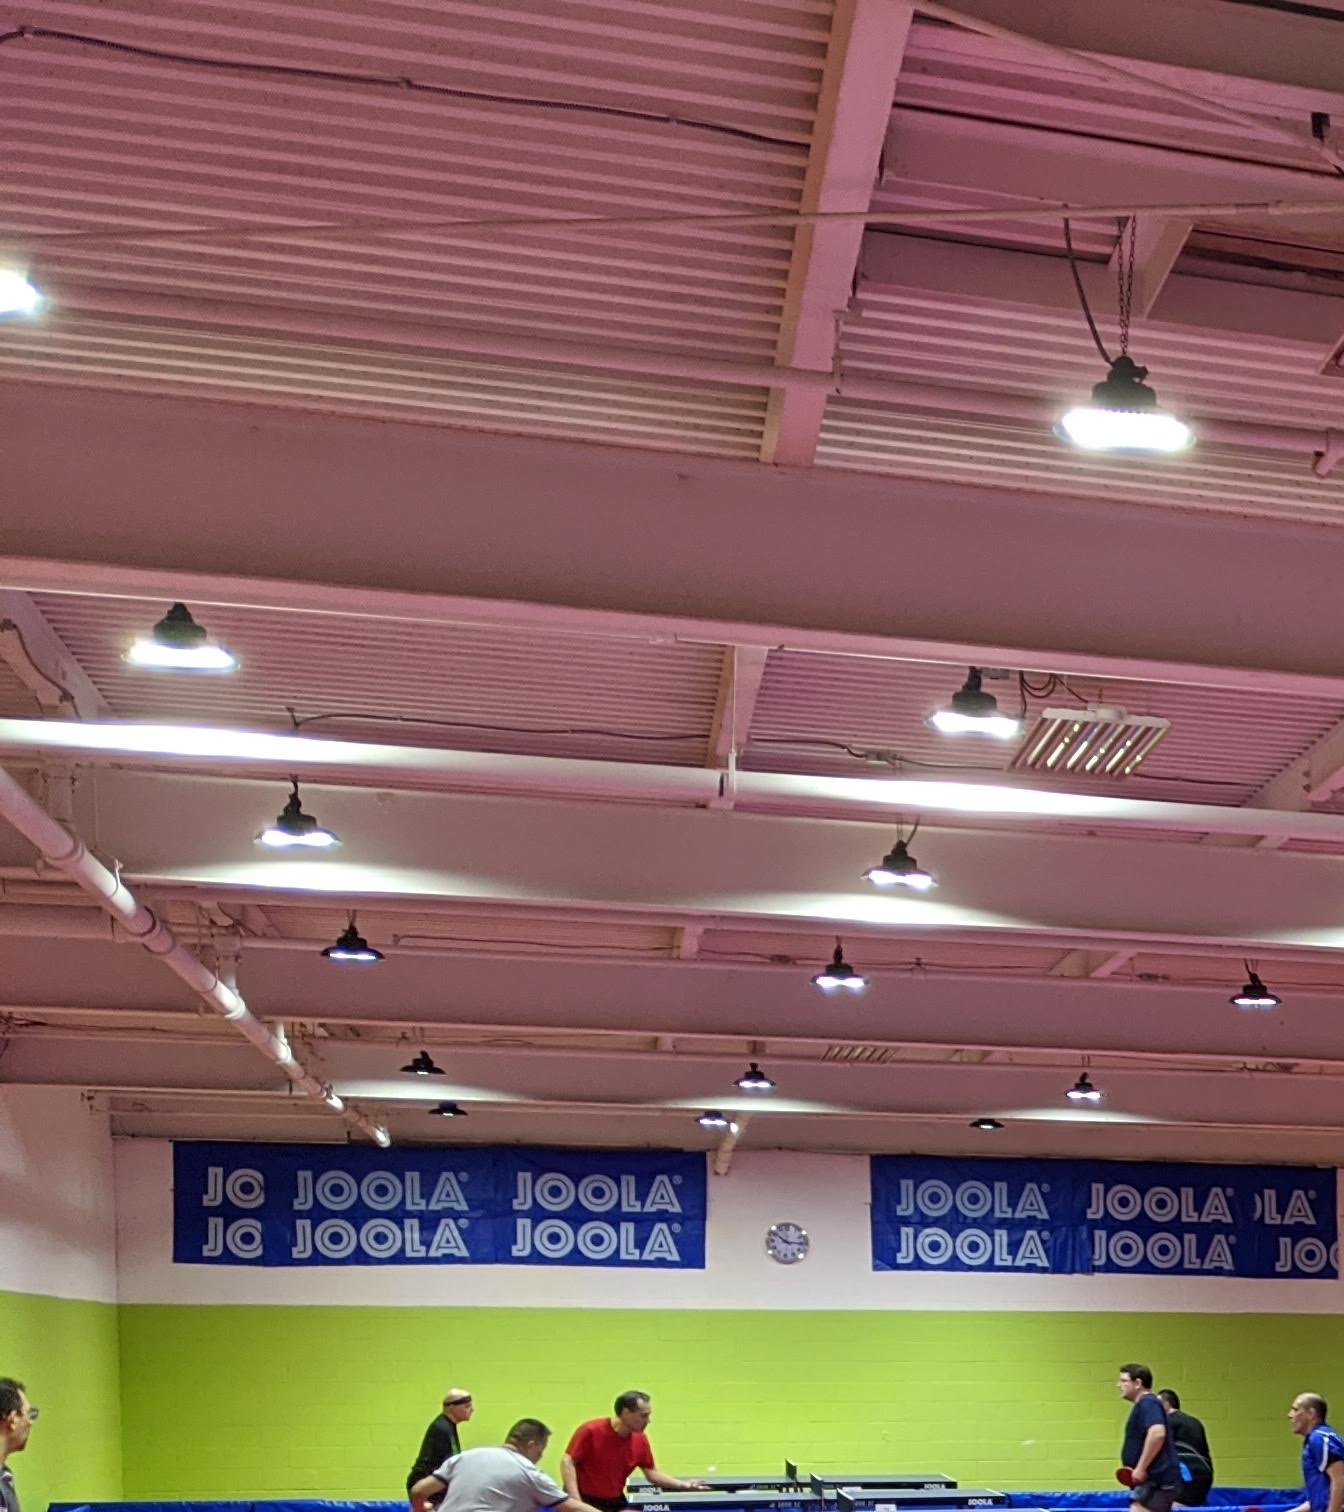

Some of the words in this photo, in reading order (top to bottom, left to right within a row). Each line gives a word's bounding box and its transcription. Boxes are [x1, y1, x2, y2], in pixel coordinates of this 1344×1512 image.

[293, 1170, 469, 1211] JOOLA
[512, 1172, 682, 1212] JOOLA
[896, 1179, 1049, 1219] JOOLA
[1087, 1183, 1233, 1223] JOOLA
[1254, 1189, 1317, 1225] LA
[291, 1218, 469, 1258] JOOLA
[512, 1218, 680, 1261] JOOLA
[896, 1227, 1049, 1267] JOOLA
[1093, 1229, 1235, 1270] JOOLA
[1275, 1237, 1337, 1272] JO
